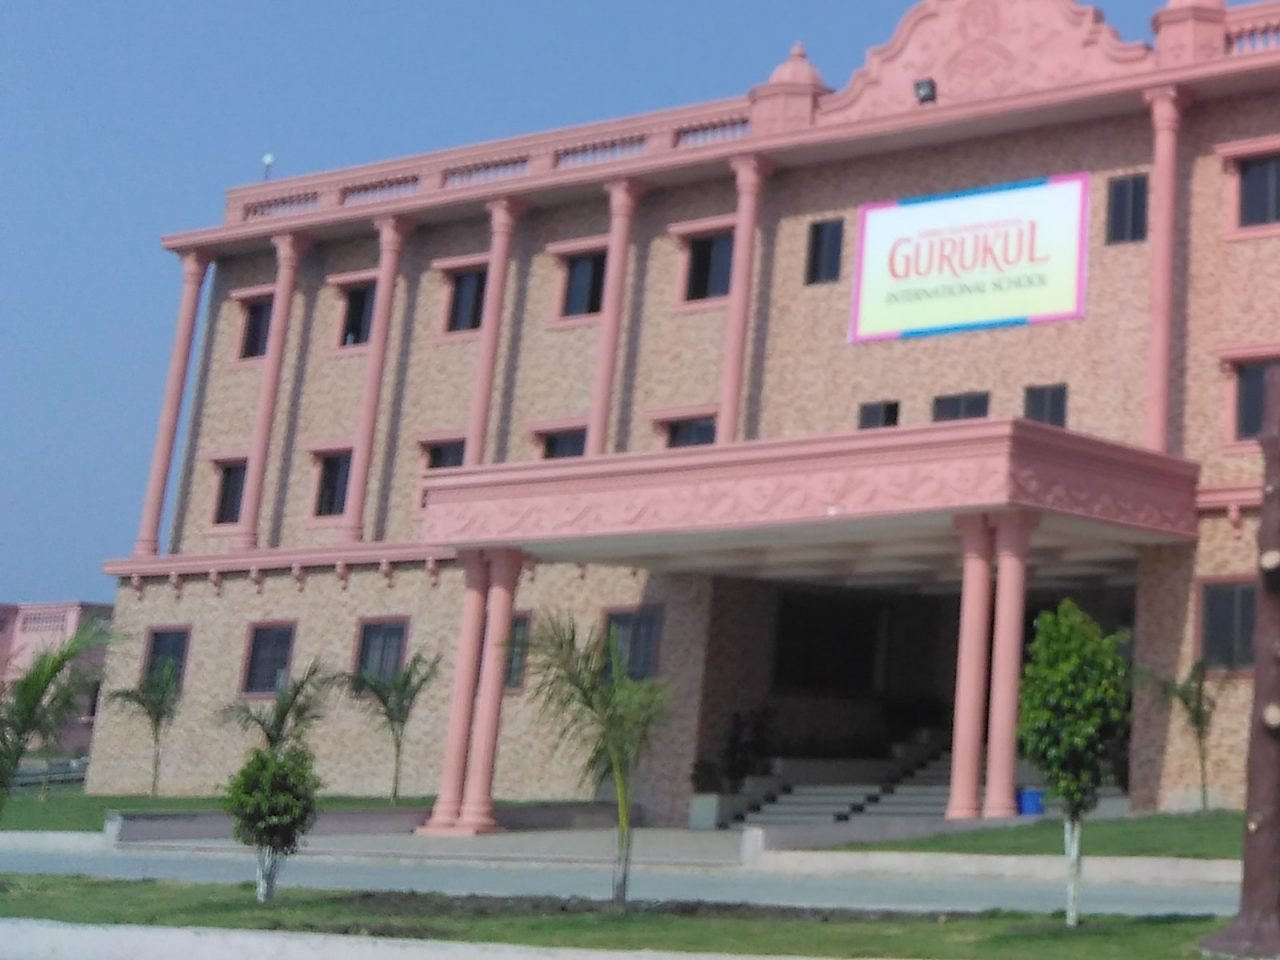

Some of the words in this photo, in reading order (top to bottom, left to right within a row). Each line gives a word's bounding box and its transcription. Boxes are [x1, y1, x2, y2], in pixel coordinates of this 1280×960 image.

[887, 219, 1050, 280] GURUKUL
[885, 280, 987, 304] INTERNATIONAL
[992, 271, 1048, 291] SCHOOL
